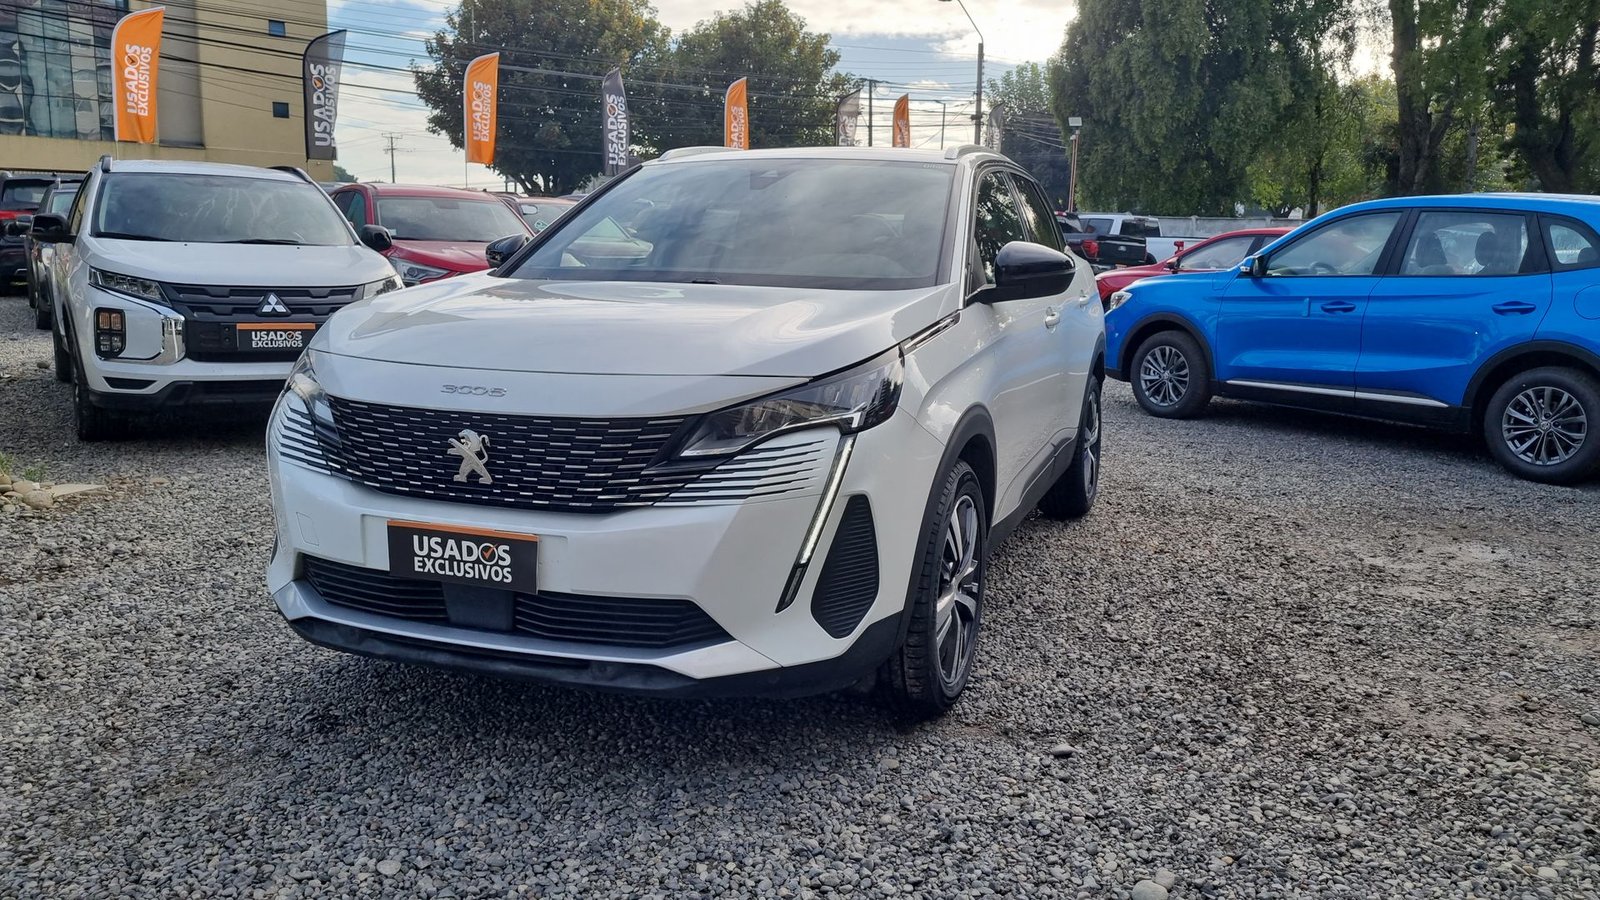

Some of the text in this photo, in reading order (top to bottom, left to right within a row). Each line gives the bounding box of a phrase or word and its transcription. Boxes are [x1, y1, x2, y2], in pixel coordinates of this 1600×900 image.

[124, 44, 141, 114] USADOS
[138, 46, 152, 116] EXCLUSIVOS
[310, 63, 331, 147] USADOS
[472, 81, 484, 140] USADOS
[480, 83, 491, 142] EXCLUSIVOS
[606, 94, 618, 165] USADOS
[617, 96, 627, 166] EXCLUSIVOS
[731, 105, 739, 148] SADOS
[251, 331, 302, 341] USADOS
[252, 340, 303, 348] EXCLUSIVOS
[413, 534, 512, 567] USADOS
[413, 556, 513, 583] EXCLUSIVOS
